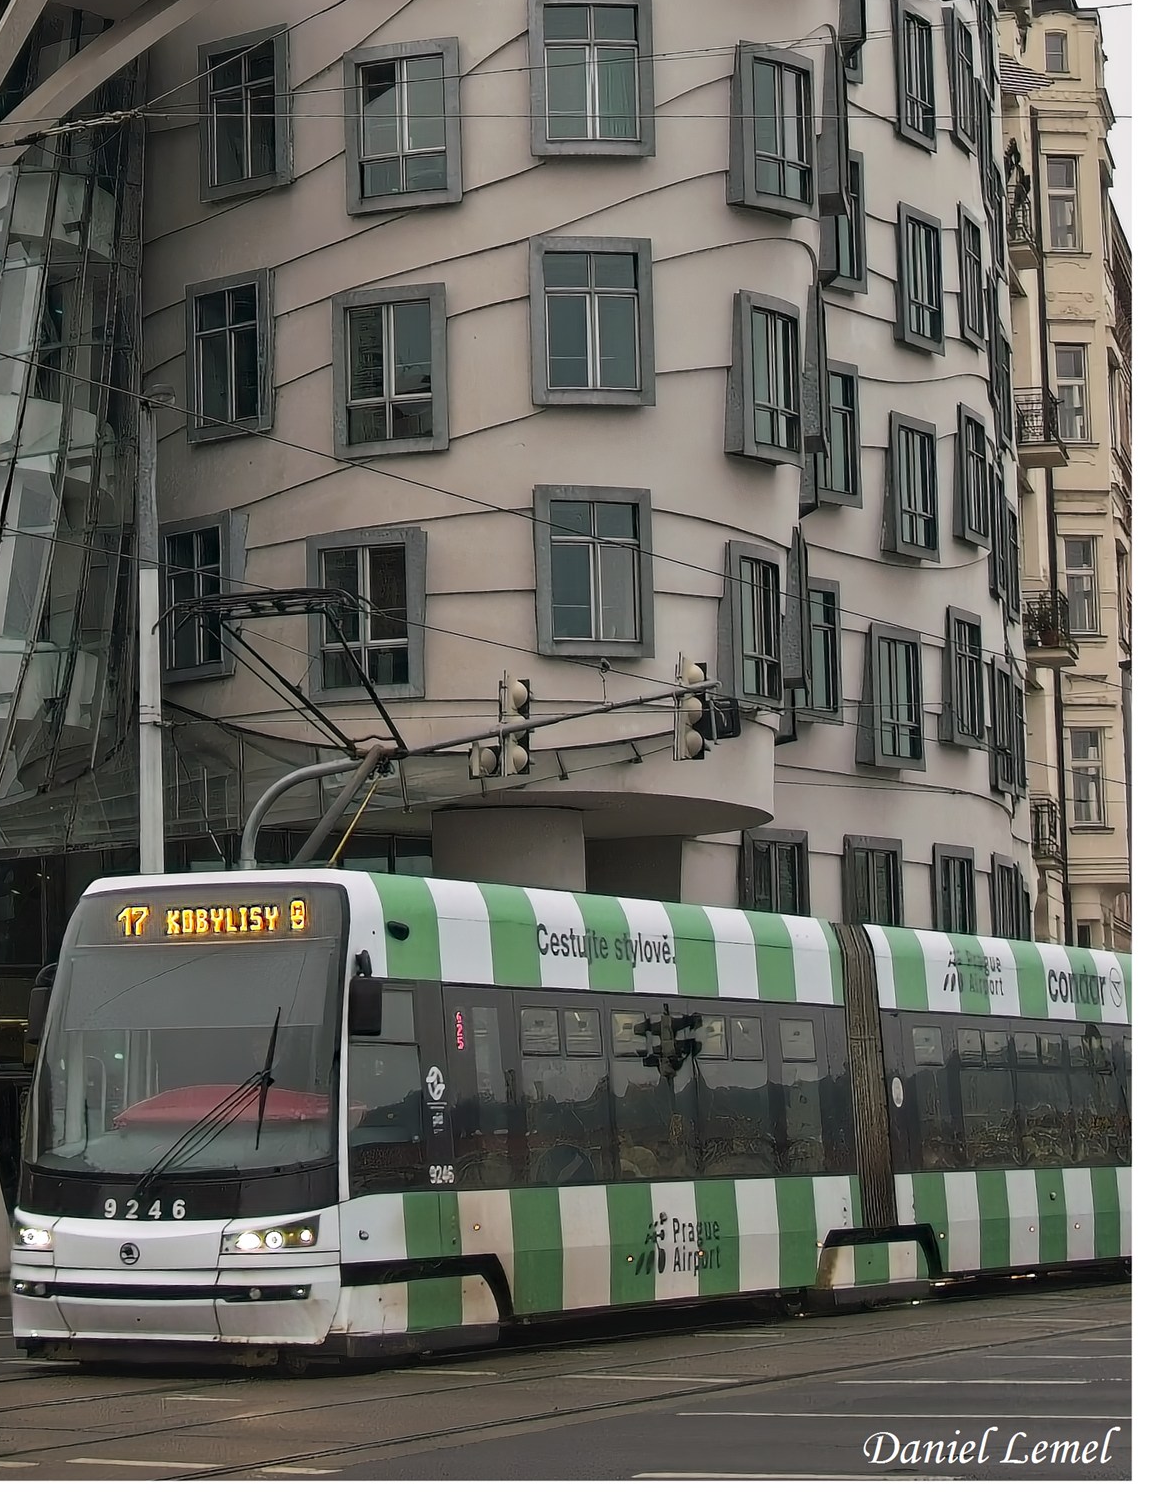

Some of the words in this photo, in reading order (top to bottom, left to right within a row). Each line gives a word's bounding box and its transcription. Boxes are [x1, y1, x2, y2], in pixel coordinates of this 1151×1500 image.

[117, 906, 150, 936] 17
[166, 906, 279, 935] KOBYLISY
[536, 923, 609, 965] Cestujte
[614, 932, 676, 969] stylově.
[966, 950, 1002, 977] Prague
[969, 973, 1004, 996] Airport
[1047, 964, 1107, 1005] condor
[429, 1165, 455, 1184] 9246
[104, 1198, 186, 1219] 9246
[672, 1217, 720, 1248] Prague
[672, 1245, 721, 1277] Airport
